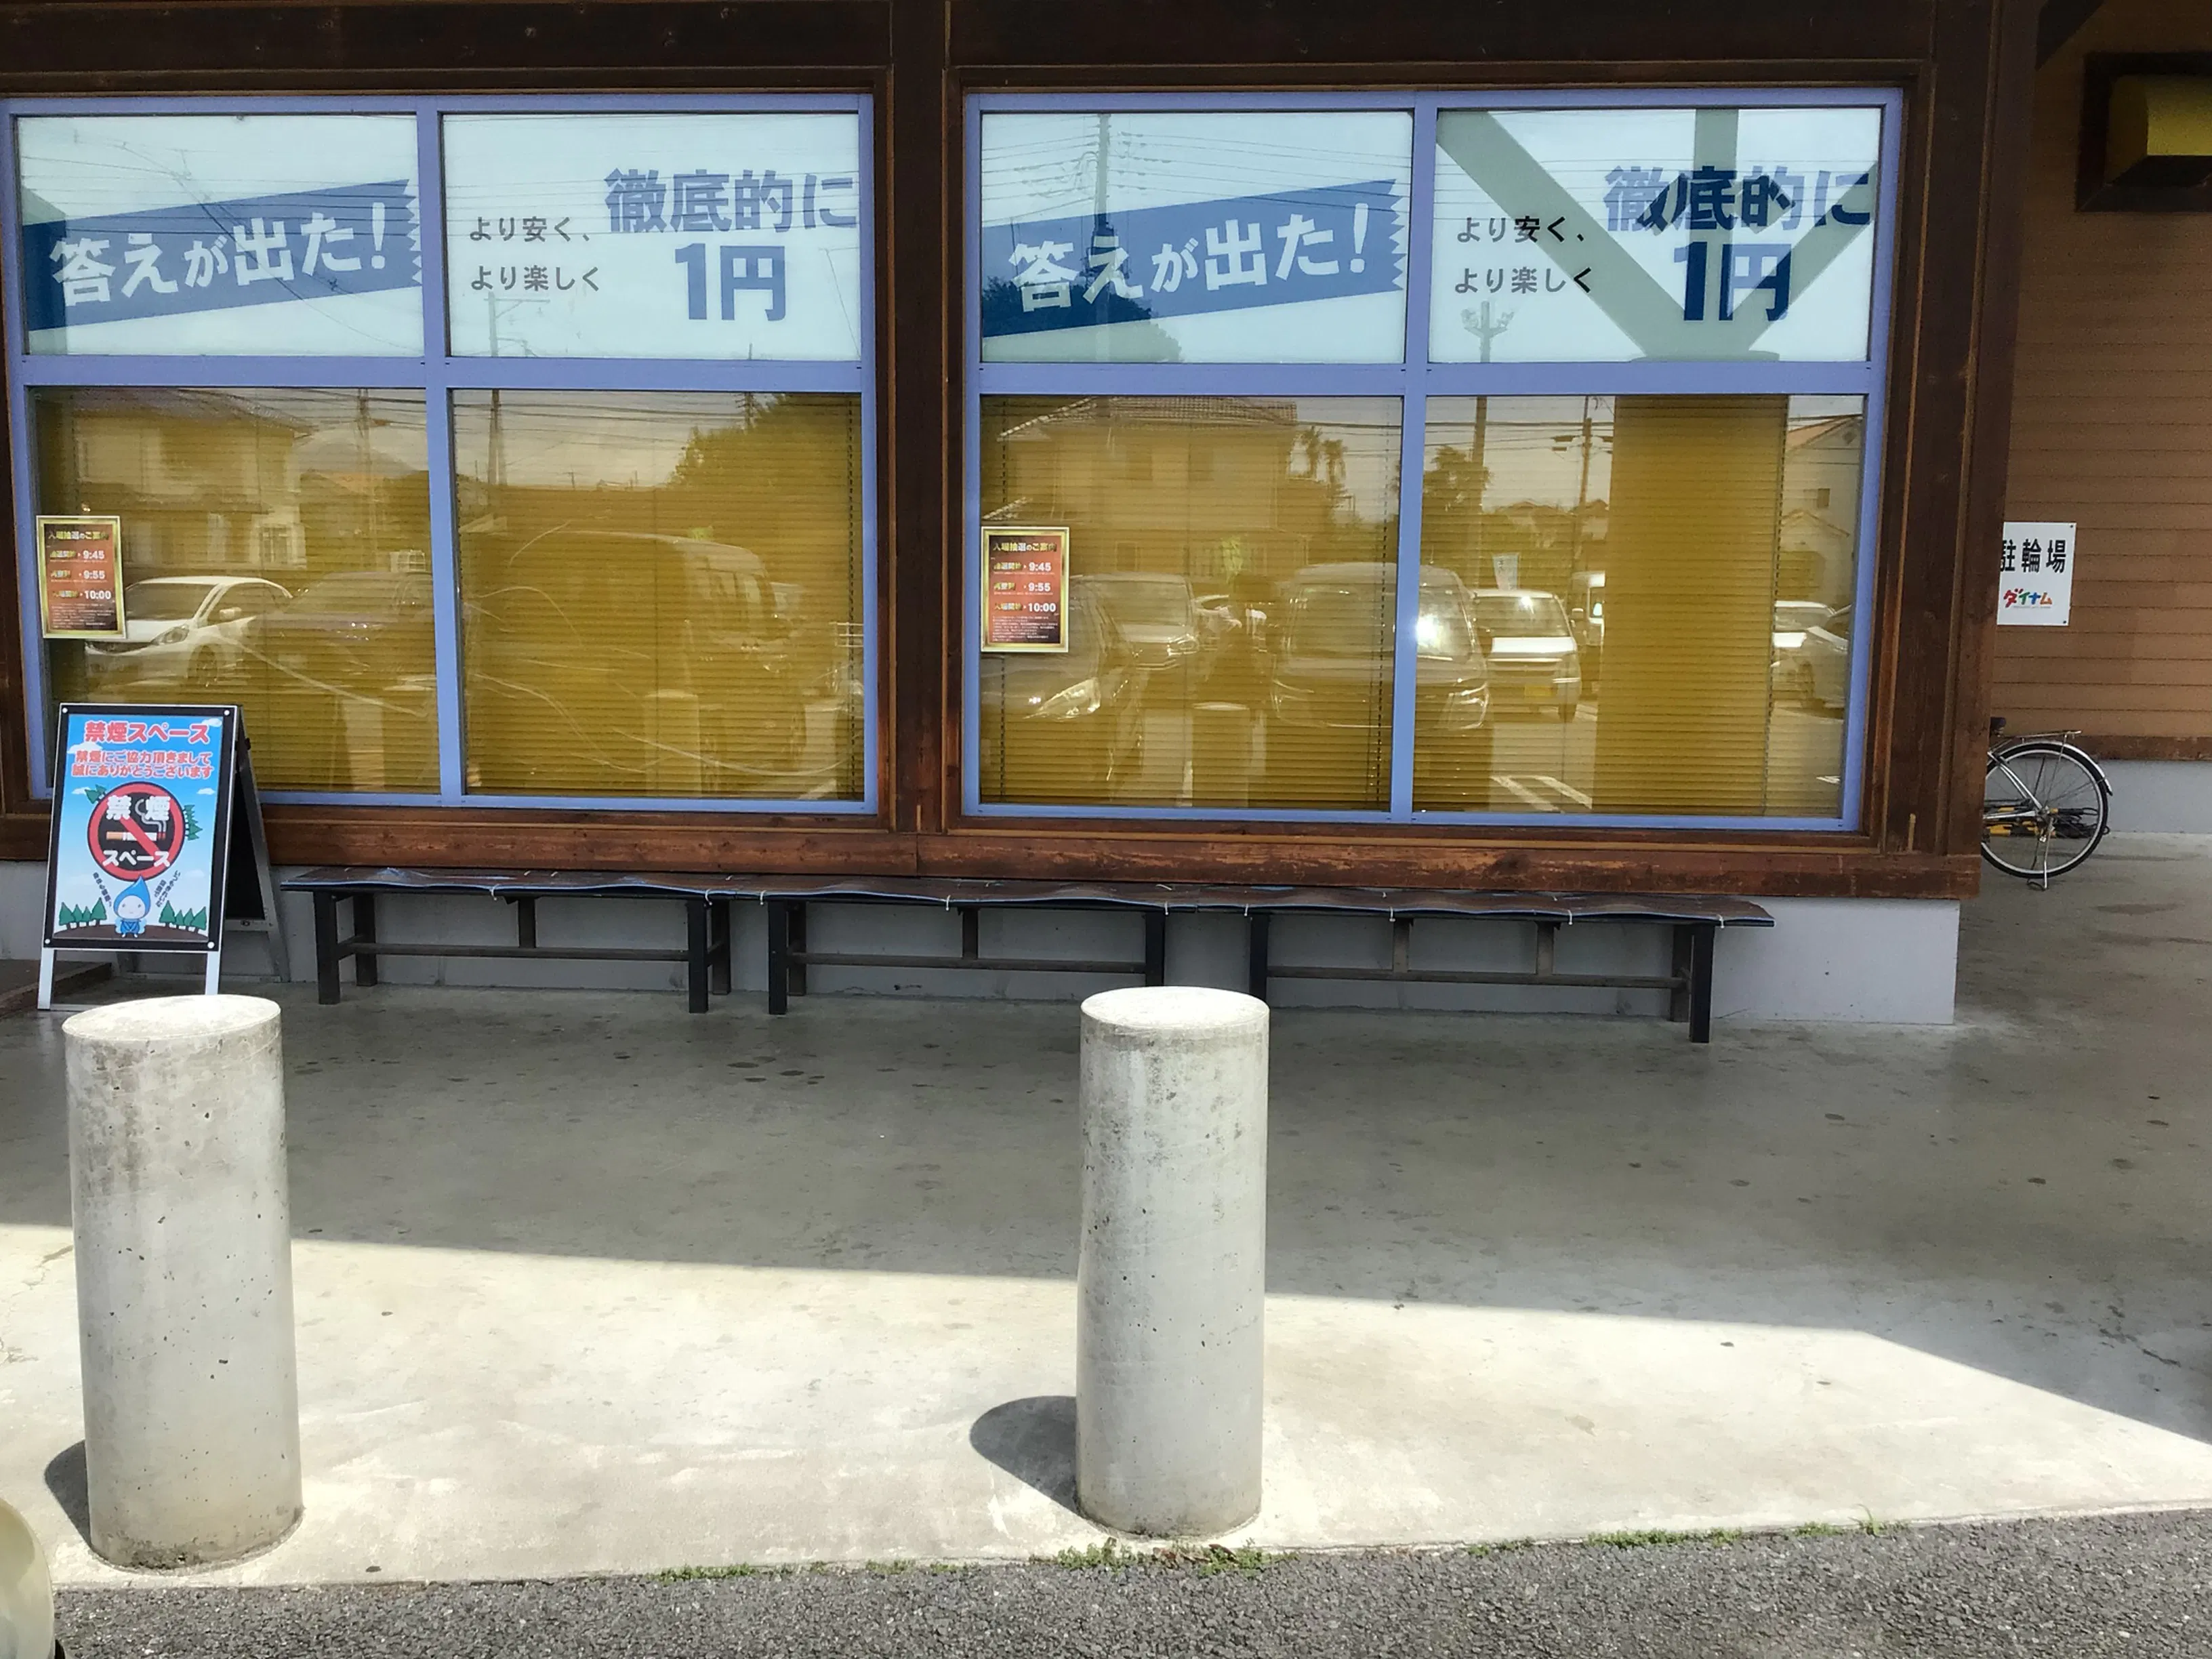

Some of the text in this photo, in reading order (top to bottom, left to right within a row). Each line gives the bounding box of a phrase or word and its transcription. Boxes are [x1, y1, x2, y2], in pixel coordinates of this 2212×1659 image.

[605, 167, 857, 233] 徹底的に
[1603, 165, 1870, 232] 徹底的に
[470, 217, 590, 242] より安く、
[1456, 216, 1584, 244] より安く、
[49, 202, 386, 307] 答えが出た!
[1008, 203, 1369, 312] 答えが出た!
[471, 265, 600, 292] より楽しく
[675, 243, 786, 321] 1円
[1454, 267, 1592, 293] より楽しく
[1675, 241, 1792, 321] 1円
[83, 550, 104, 560] 9:45
[1029, 561, 1051, 572] 9:45
[2001, 539, 2066, 573] 駐輪場
[83, 570, 105, 579] 9:55
[84, 590, 111, 600] 10:00
[1028, 582, 1051, 592] 9:55
[2003, 588, 2053, 608] ダイナム
[1028, 602, 1057, 612] 10:00
[85, 720, 210, 744] 禁煙スペース
[75, 750, 212, 766] 禁煙にご協力頂きまして
[71, 763, 213, 779] 誠にありがとうございます
[103, 850, 171, 867] スペース
